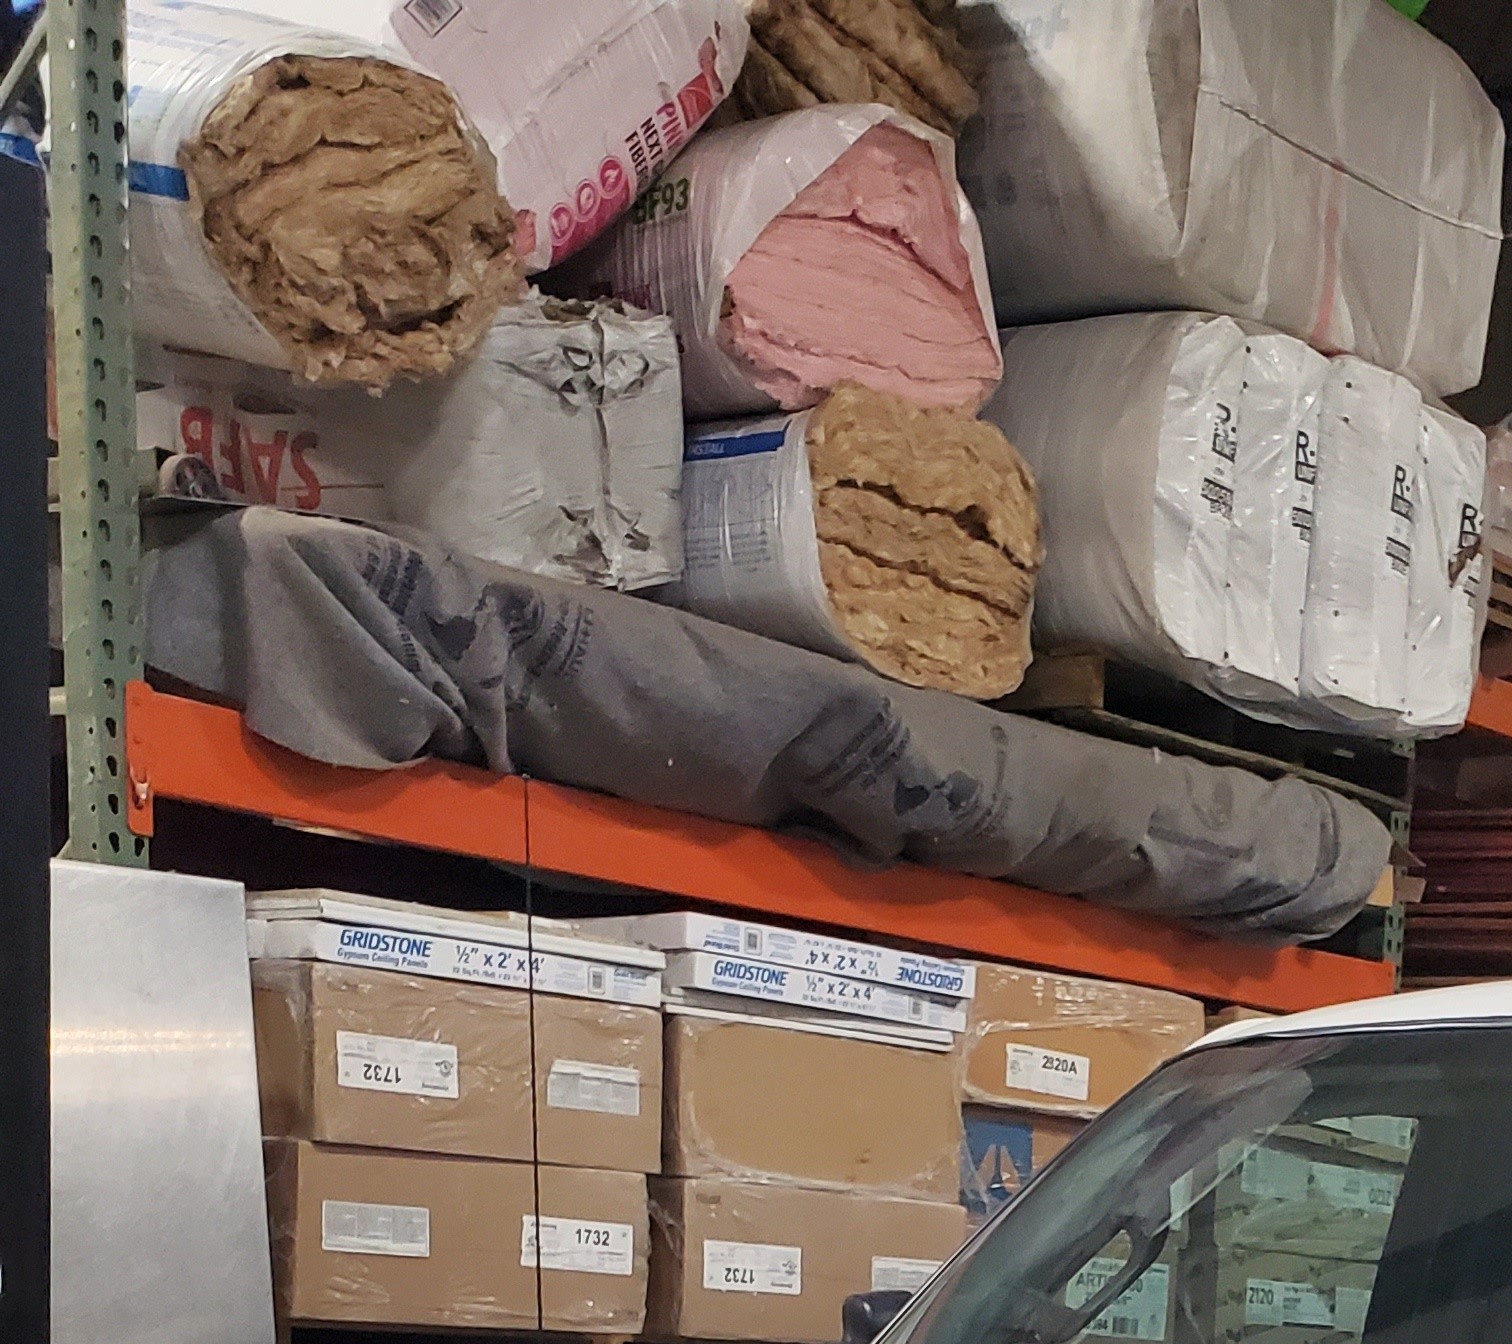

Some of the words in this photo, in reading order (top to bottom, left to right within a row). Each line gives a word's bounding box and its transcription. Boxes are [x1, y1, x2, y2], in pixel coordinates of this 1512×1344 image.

[641, 117, 664, 162] NEXT
[340, 929, 433, 959] GRIDSTONE
[713, 959, 789, 986] GRIDSTONE
[895, 966, 964, 992] GRIDSTONE
[363, 1063, 402, 1084] 1732
[575, 1228, 610, 1248] 1732
[724, 1267, 755, 1284] 1732
[1248, 1286, 1275, 1306] 2120
